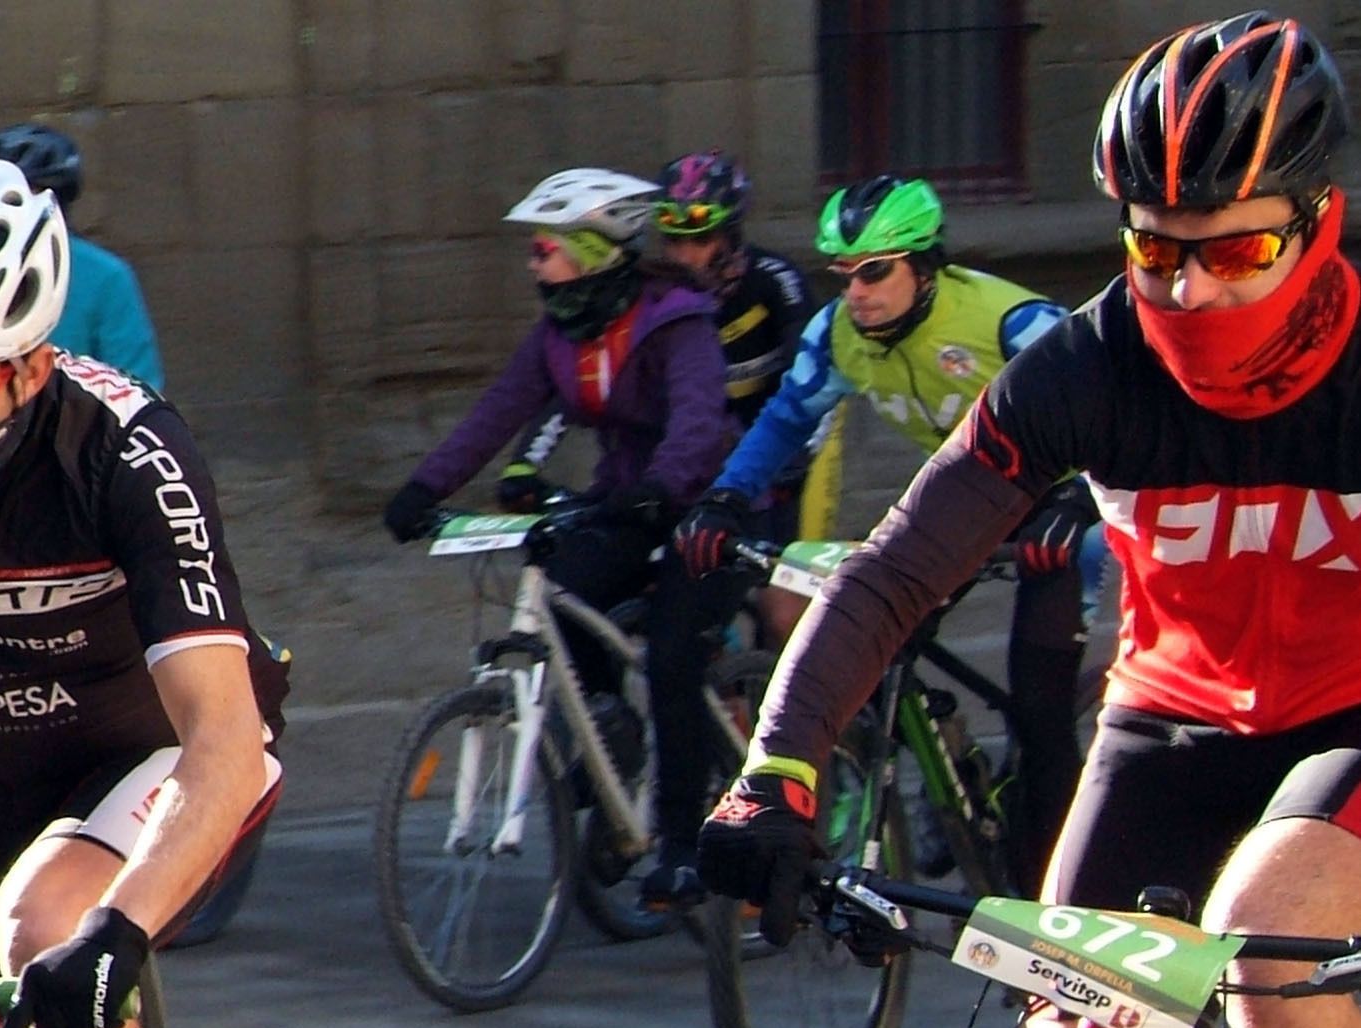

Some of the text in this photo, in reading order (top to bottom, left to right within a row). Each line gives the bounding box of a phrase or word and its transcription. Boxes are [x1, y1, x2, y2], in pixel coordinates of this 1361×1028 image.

[119, 425, 226, 621] SPORTS
[1038, 906, 1177, 983] 672
[1027, 958, 1112, 1009] Servitop
